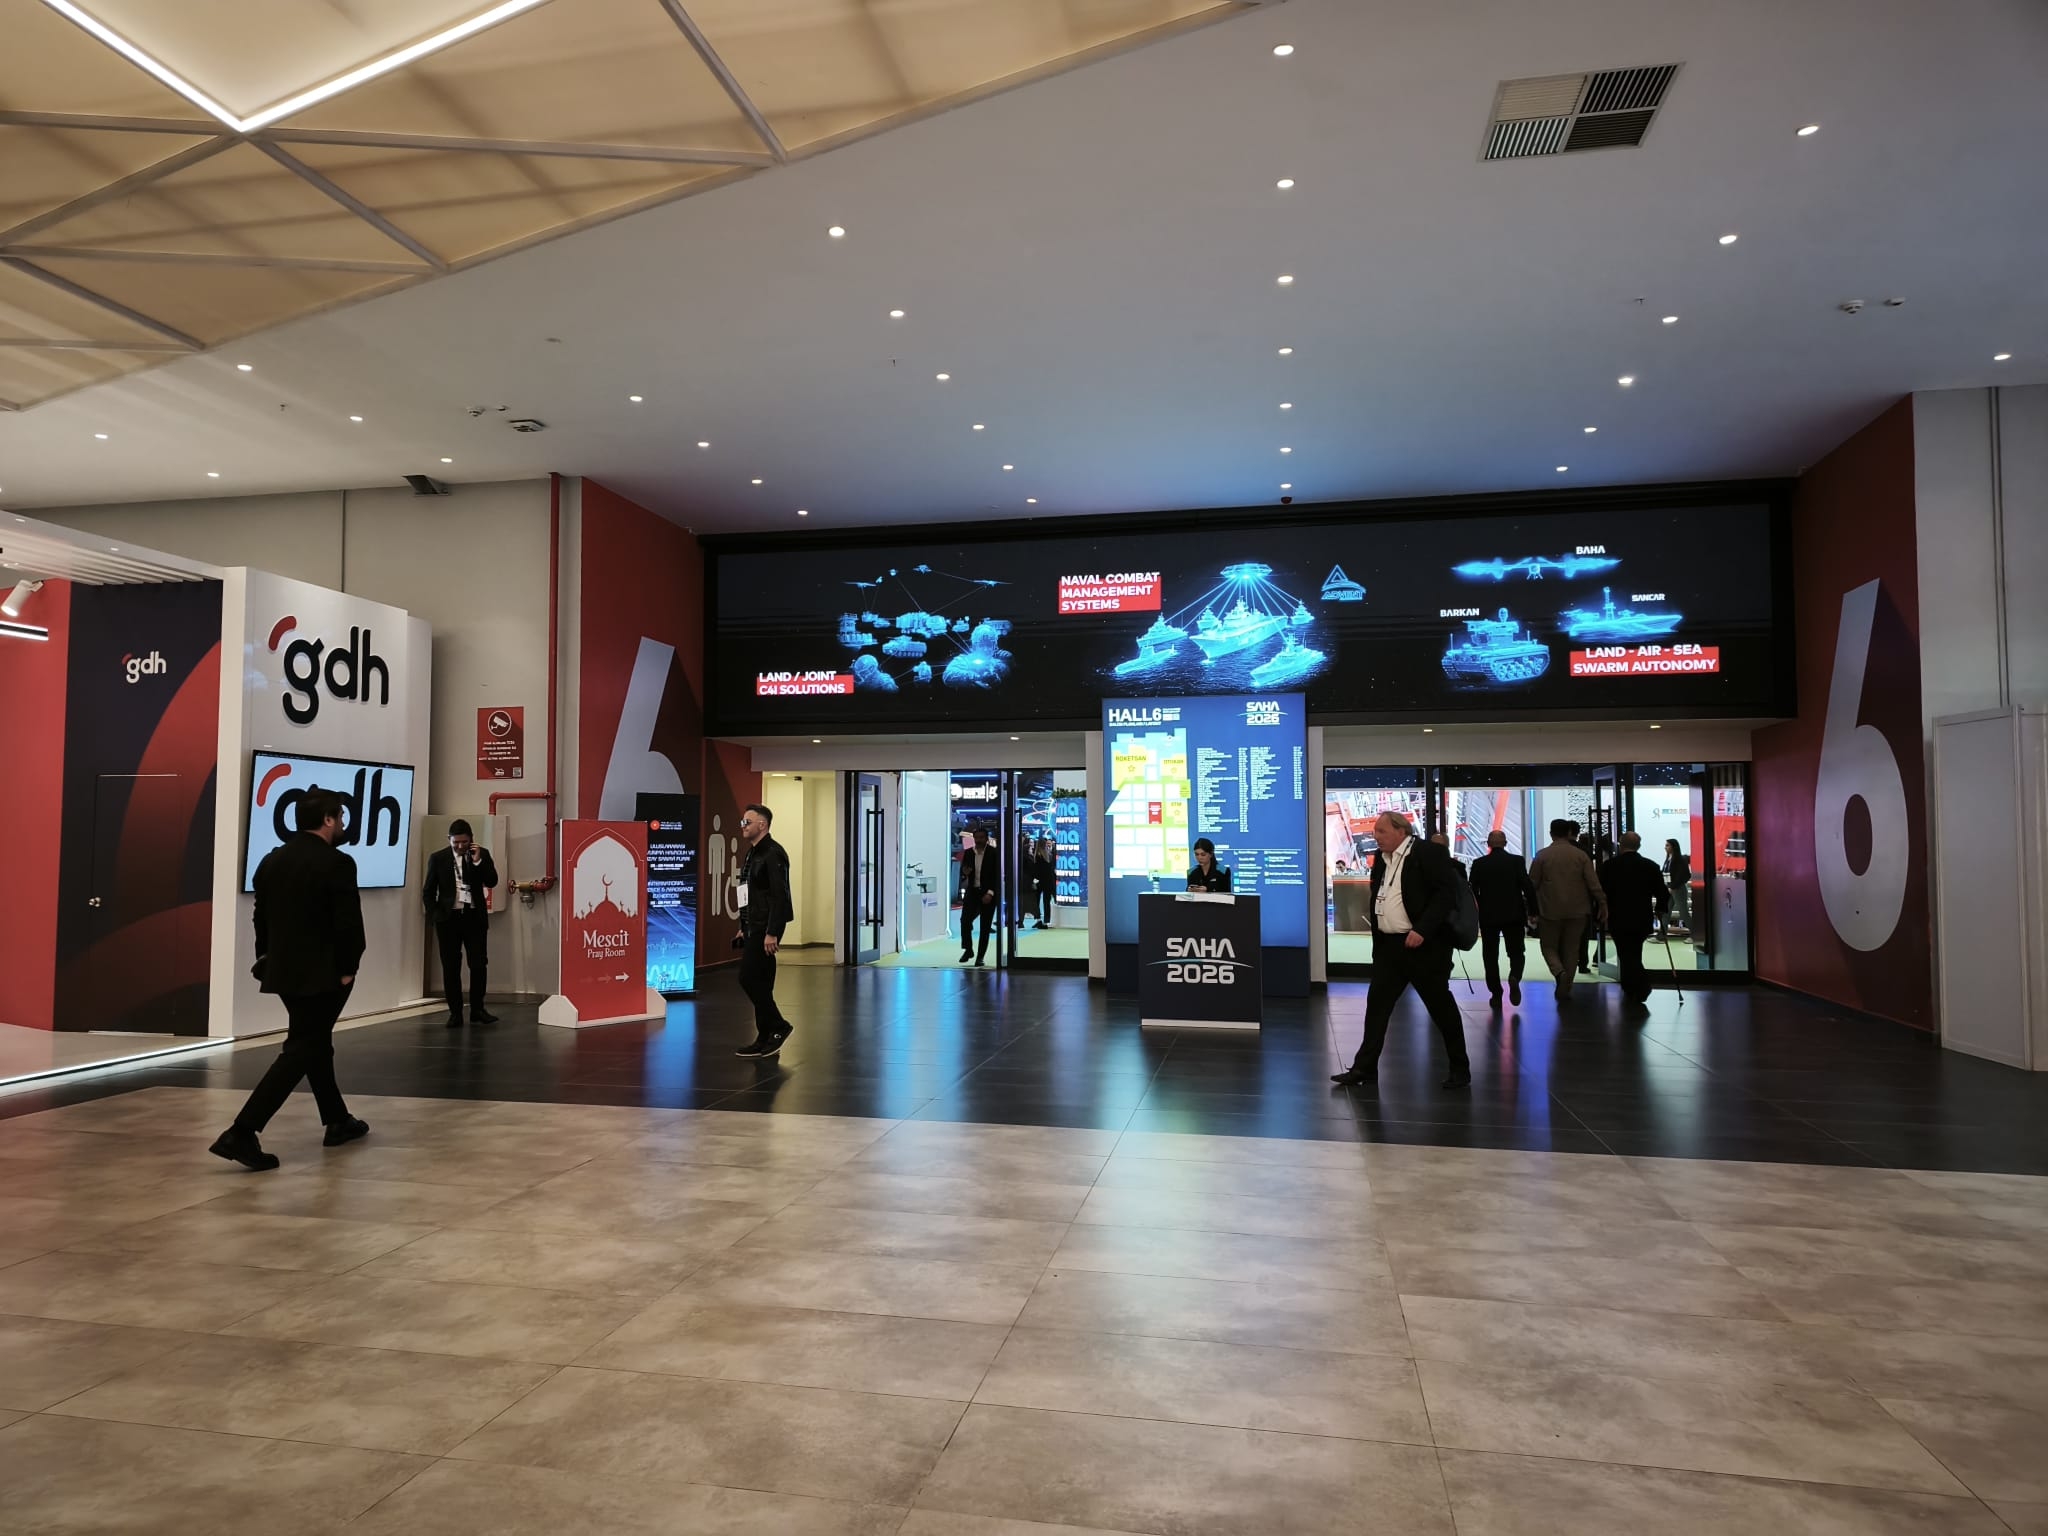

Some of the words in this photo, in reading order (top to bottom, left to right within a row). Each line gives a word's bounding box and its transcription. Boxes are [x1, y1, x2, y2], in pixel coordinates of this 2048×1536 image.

[1576, 545, 1606, 555] BAHA
[1061, 574, 1103, 586] NAVAL
[1105, 572, 1160, 584] COMBAT
[1061, 585, 1153, 598] MANAGEMENT
[1631, 593, 1665, 602] SANCAR
[1061, 599, 1120, 611] SYSTEMS
[1440, 608, 1480, 617] BARKAN
[1586, 647, 1626, 659] LAND
[1637, 645, 1661, 657] AIR
[1673, 643, 1703, 656] SEA
[125, 650, 167, 684] gdh
[1573, 661, 1629, 674] SWARM
[1631, 659, 1716, 672] AUTONOMY
[282, 626, 389, 724] gdh
[759, 672, 791, 682] LAND
[793, 672, 801, 682] /
[802, 671, 836, 681] JOINT
[780, 683, 845, 695] SOLUTIONS
[1246, 700, 1280, 712] SAHA
[1246, 713, 1280, 724] 2026
[1815, 578, 1909, 951] 6
[583, 929, 630, 949] Mescit
[587, 948, 604, 960] Pray
[605, 947, 626, 958] Room
[1166, 937, 1236, 959] SAHA
[1167, 963, 1235, 985] 2026
